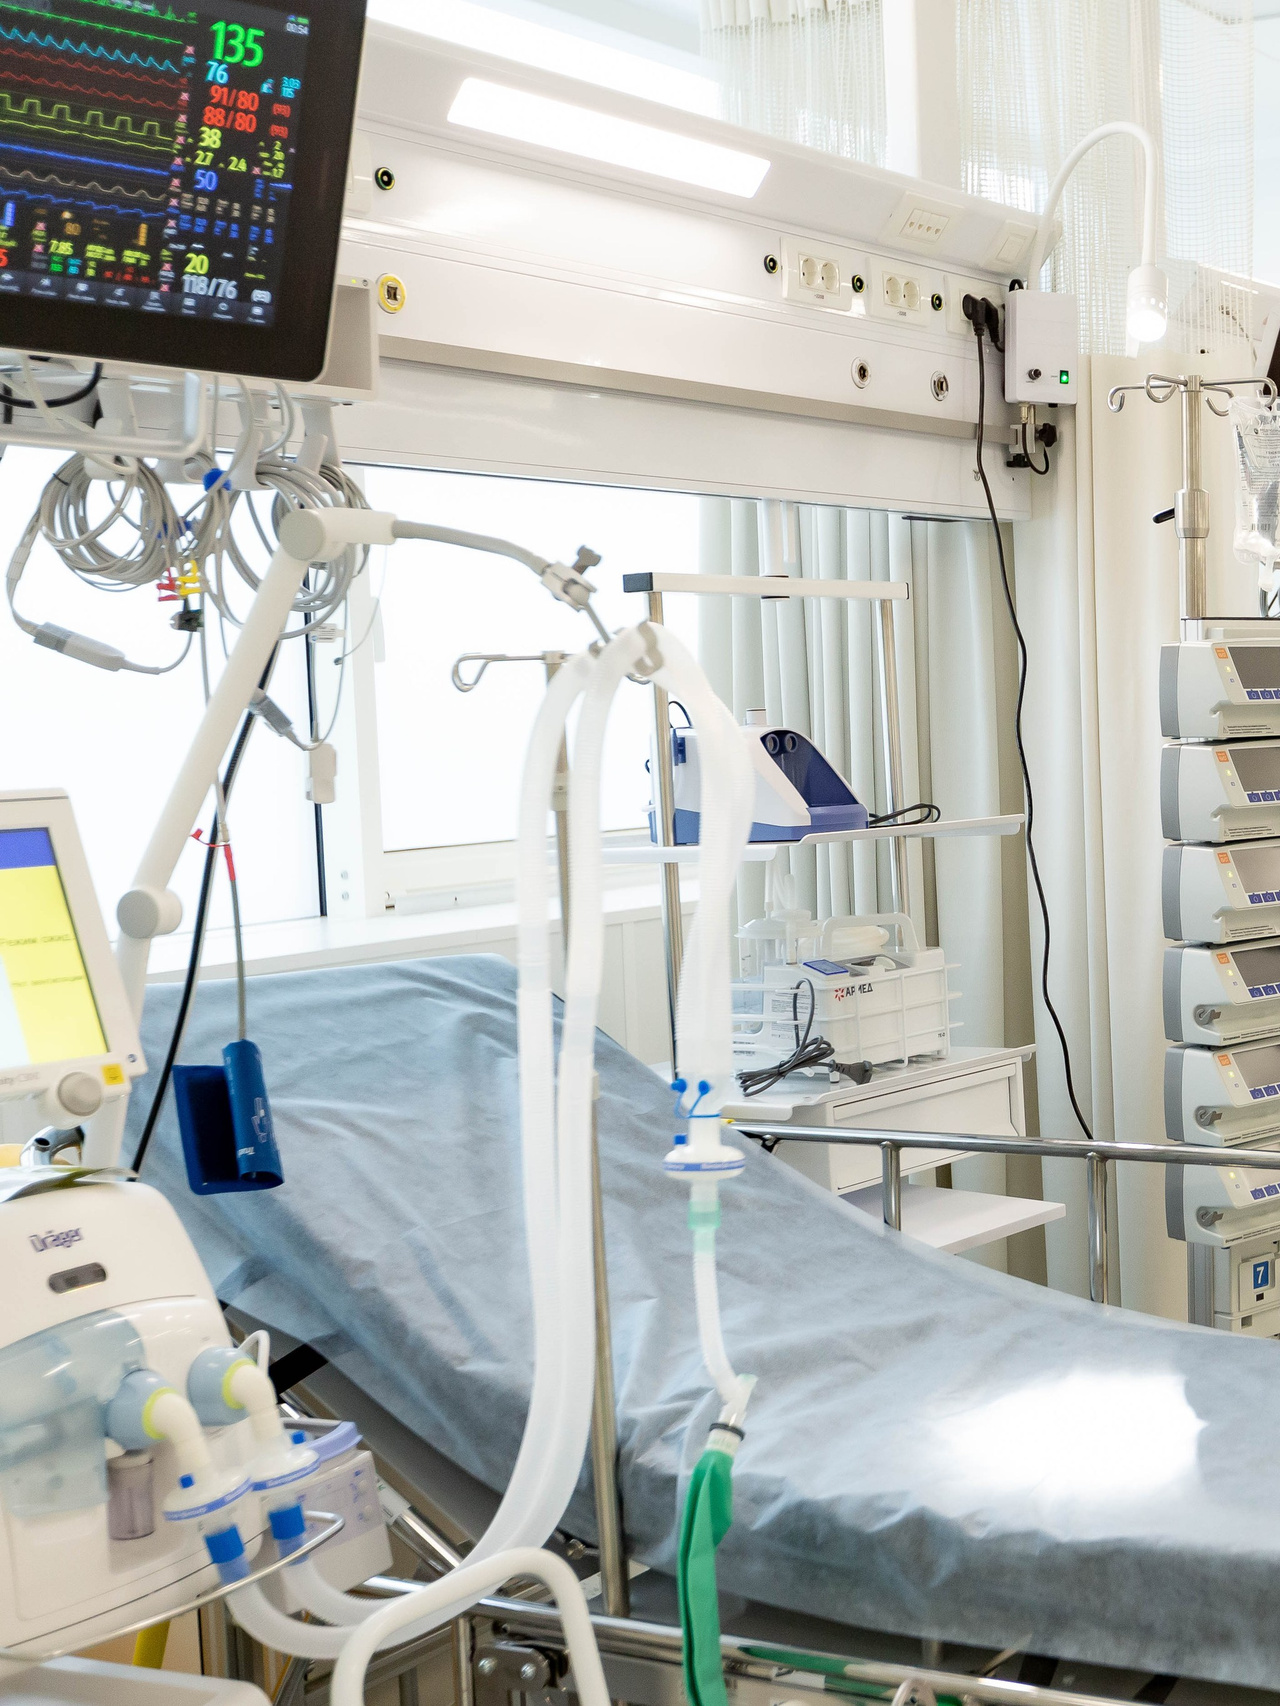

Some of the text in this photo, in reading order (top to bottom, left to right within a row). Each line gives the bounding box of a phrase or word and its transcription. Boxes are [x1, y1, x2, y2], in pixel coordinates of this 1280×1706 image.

[210, 21, 265, 67] 135
[205, 60, 229, 84] 76
[210, 85, 259, 112] 91/80
[203, 105, 257, 133] 88/80
[198, 126, 222, 149] 38
[194, 150, 247, 172] 27 24
[194, 168, 218, 191] 50
[183, 252, 209, 275] 20
[181, 273, 237, 300] 118/76
[28, 1228, 83, 1252] Dräger
[1256, 1266, 1265, 1284] 7
